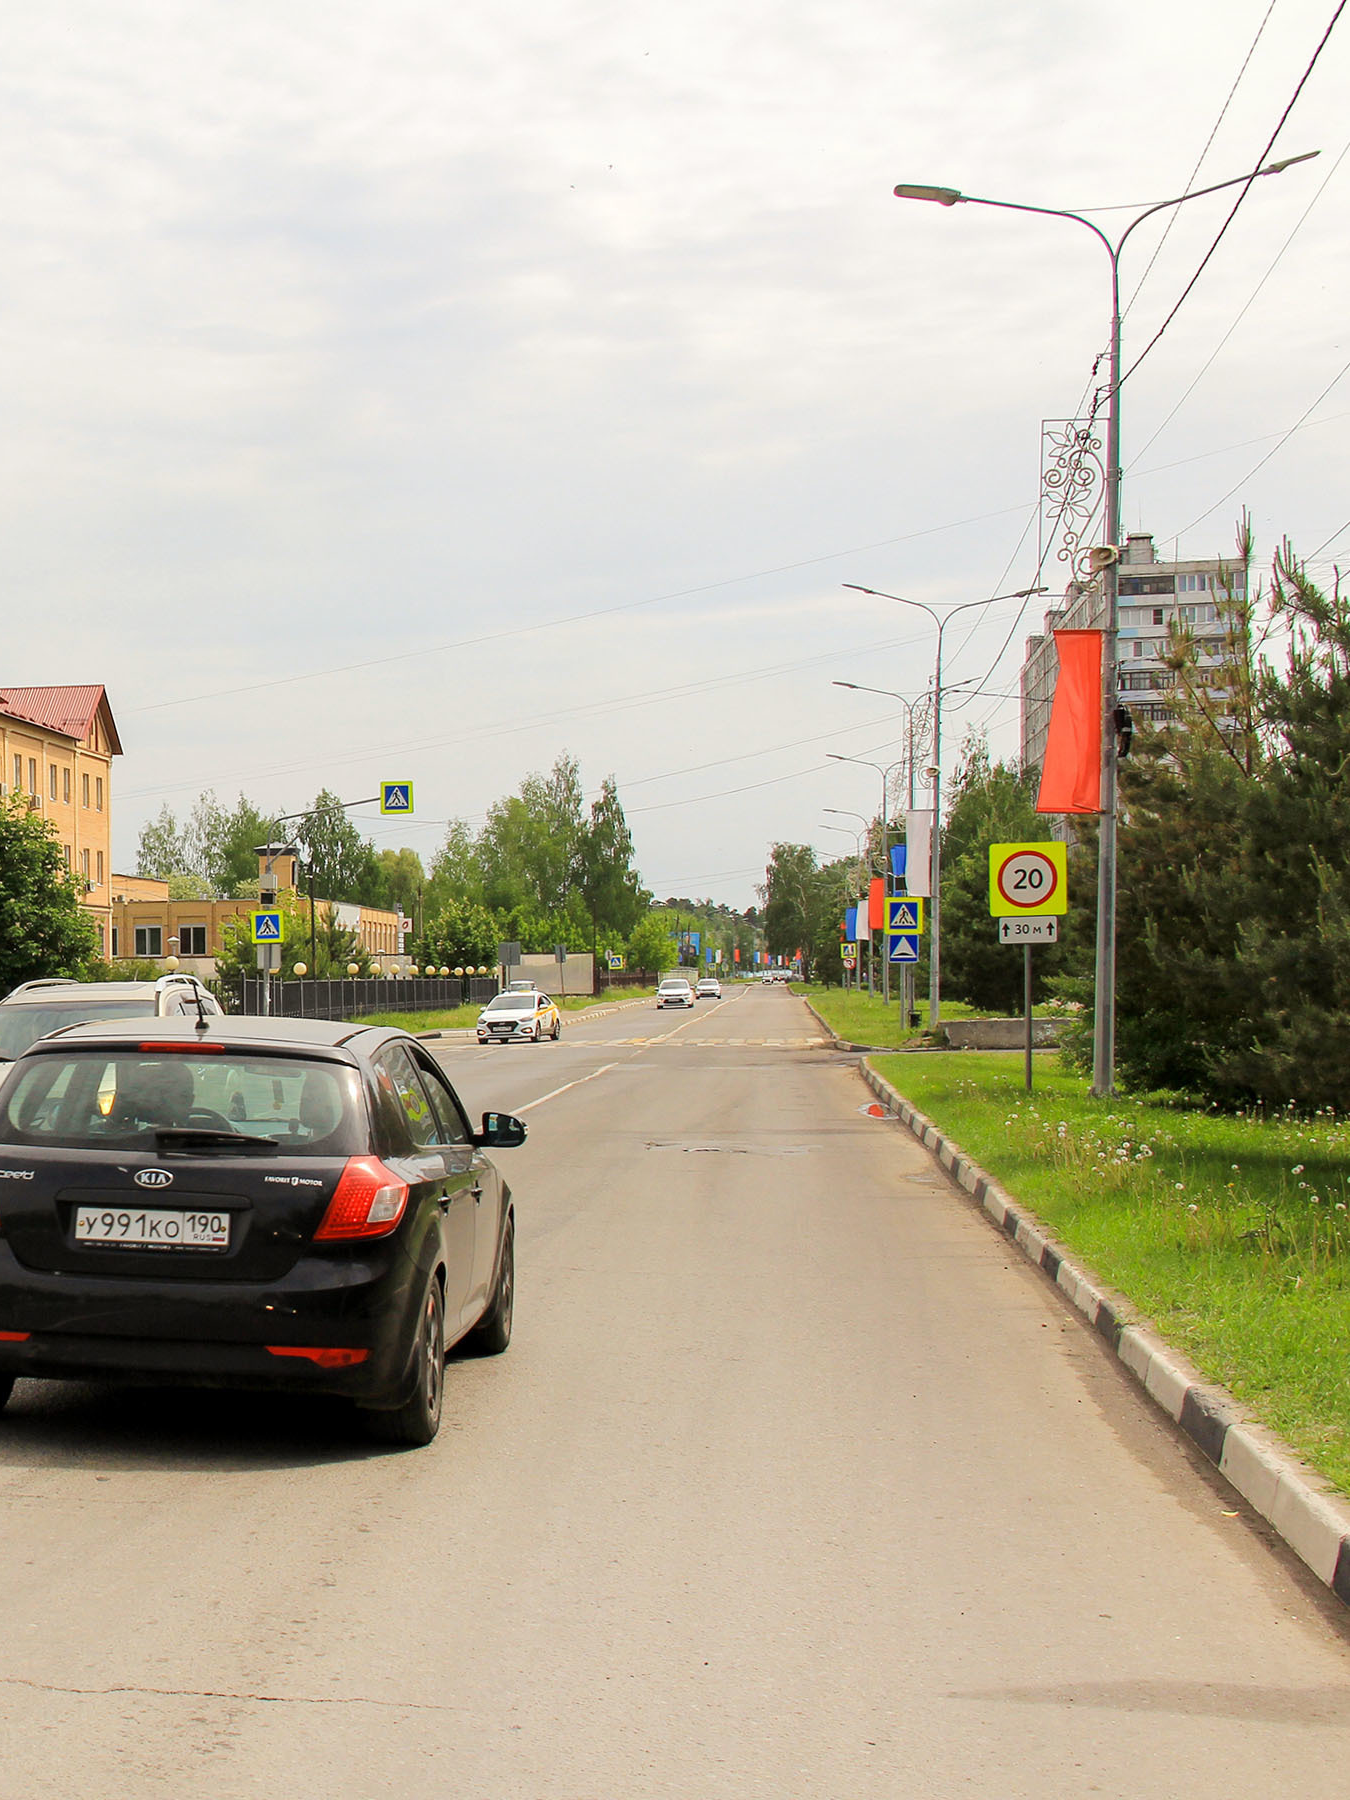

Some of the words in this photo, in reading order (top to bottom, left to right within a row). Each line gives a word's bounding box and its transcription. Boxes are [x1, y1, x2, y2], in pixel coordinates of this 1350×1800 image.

[1013, 868, 1043, 889] 20
[1015, 924, 1029, 934] 30
[140, 1172, 167, 1184] KIA
[186, 1214, 222, 1233] 190
[193, 1233, 211, 1241] RUS
